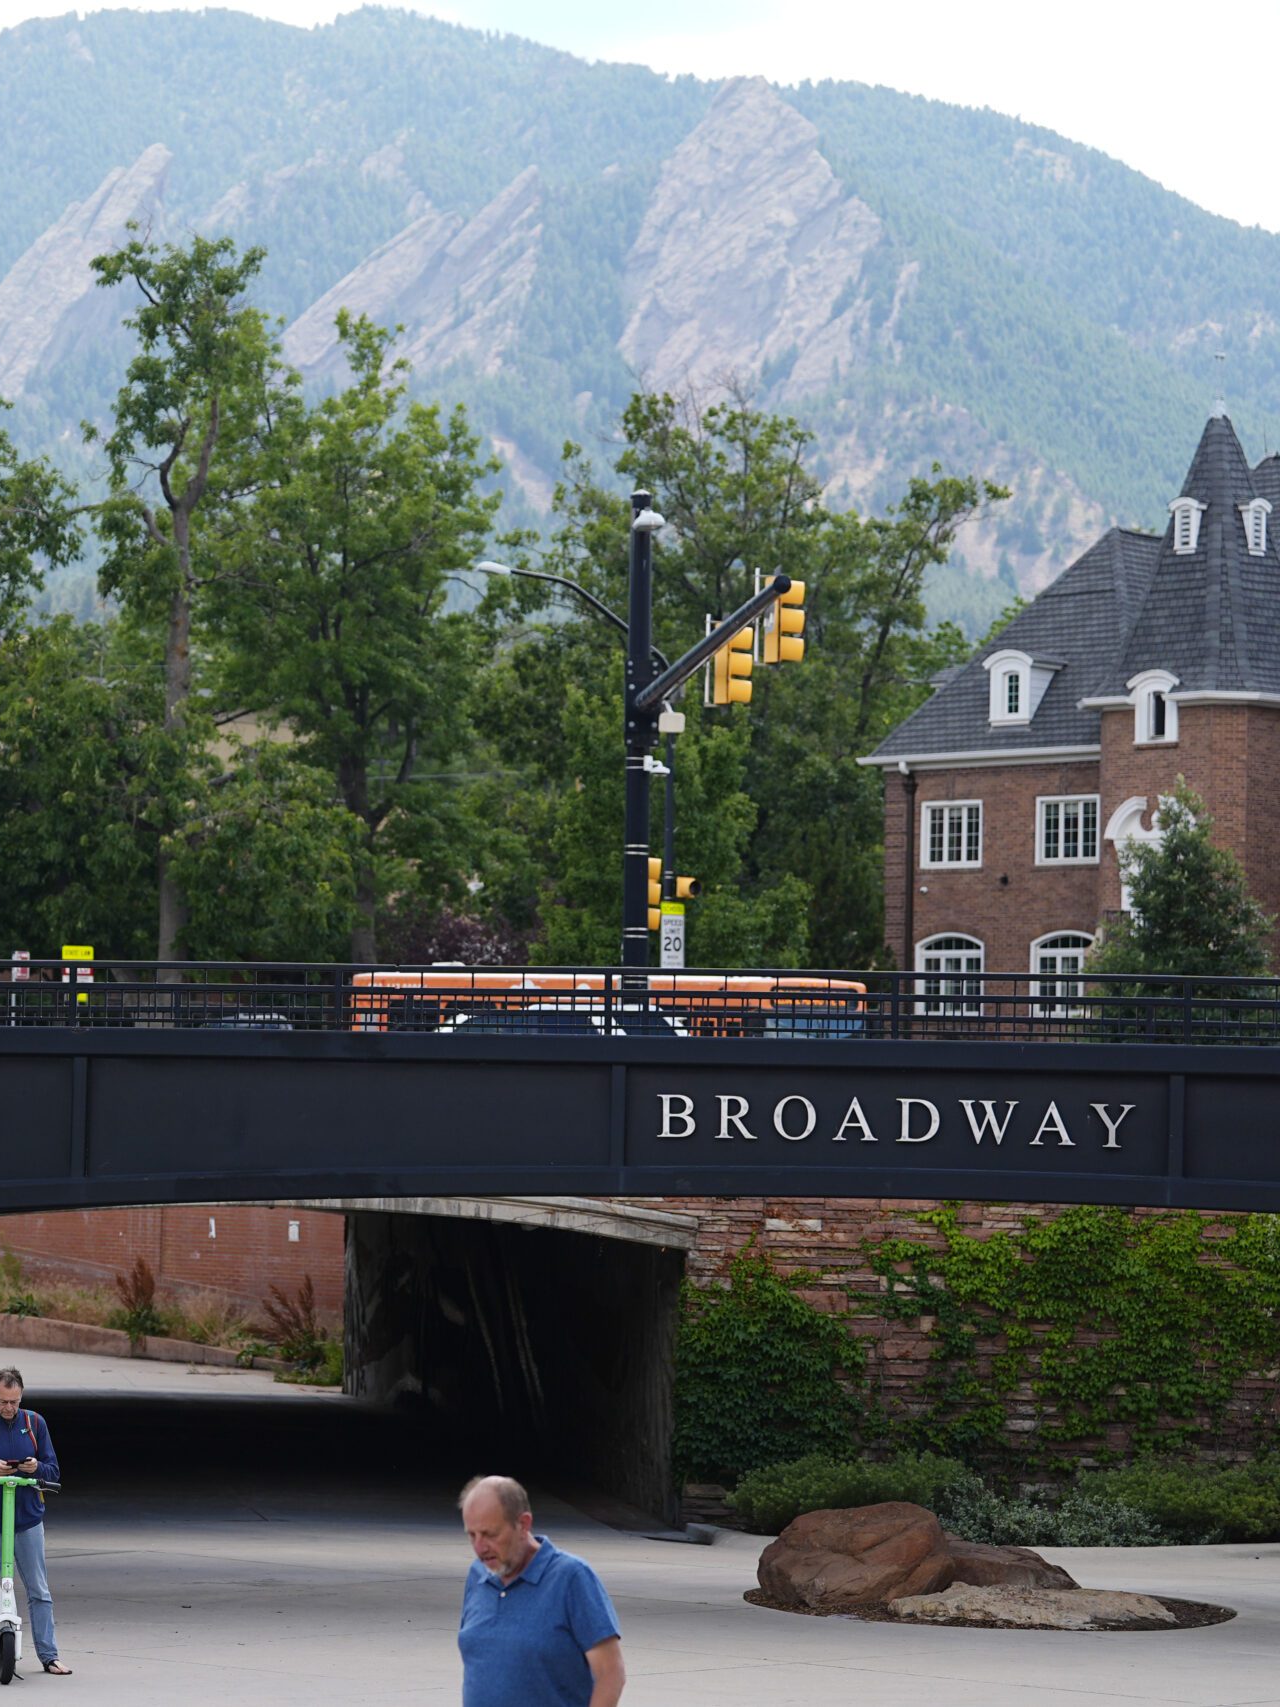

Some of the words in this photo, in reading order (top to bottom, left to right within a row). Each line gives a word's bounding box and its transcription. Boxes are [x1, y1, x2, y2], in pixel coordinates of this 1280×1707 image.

[663, 919, 683, 927] SPEED
[663, 936, 682, 952] 20
[656, 1093, 1136, 1149] BROADWAY
